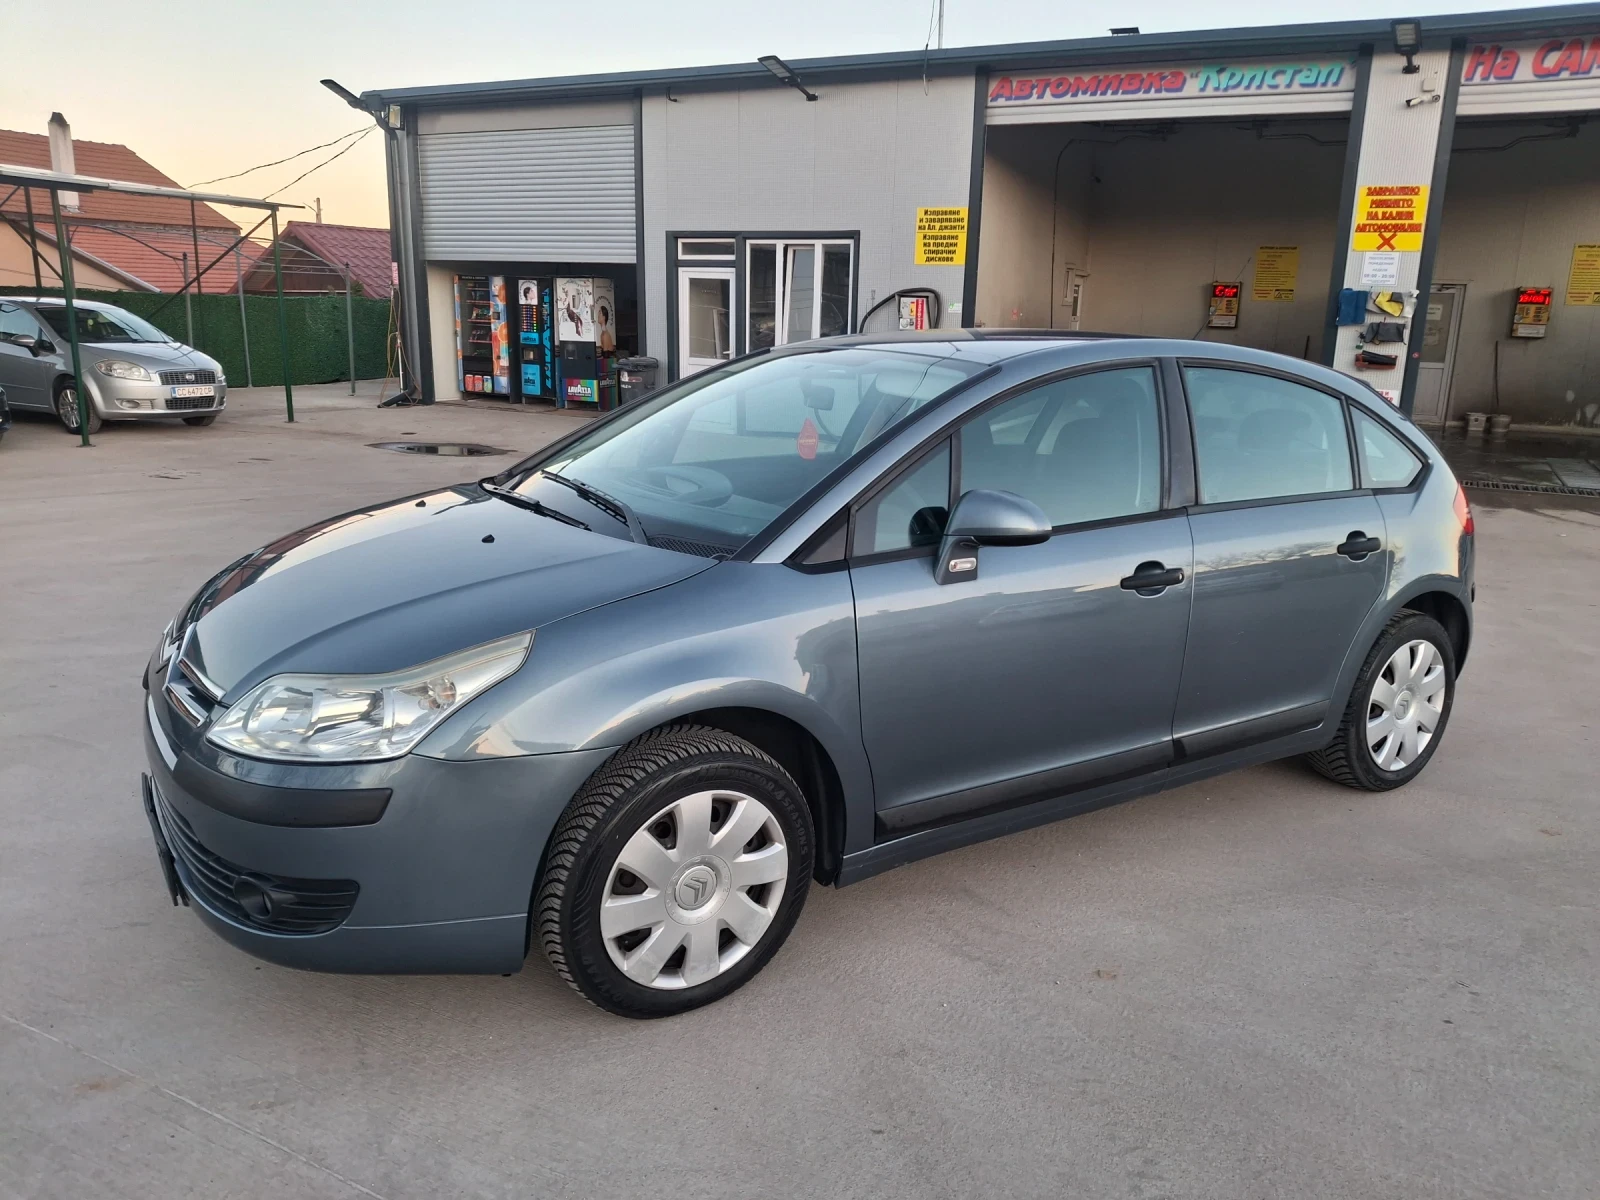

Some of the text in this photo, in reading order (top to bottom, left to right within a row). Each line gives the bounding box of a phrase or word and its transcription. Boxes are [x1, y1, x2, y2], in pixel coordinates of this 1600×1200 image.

[1463, 44, 1520, 82] На
[989, 70, 1187, 102] Автомивка
[1366, 211, 1379, 220] НА
